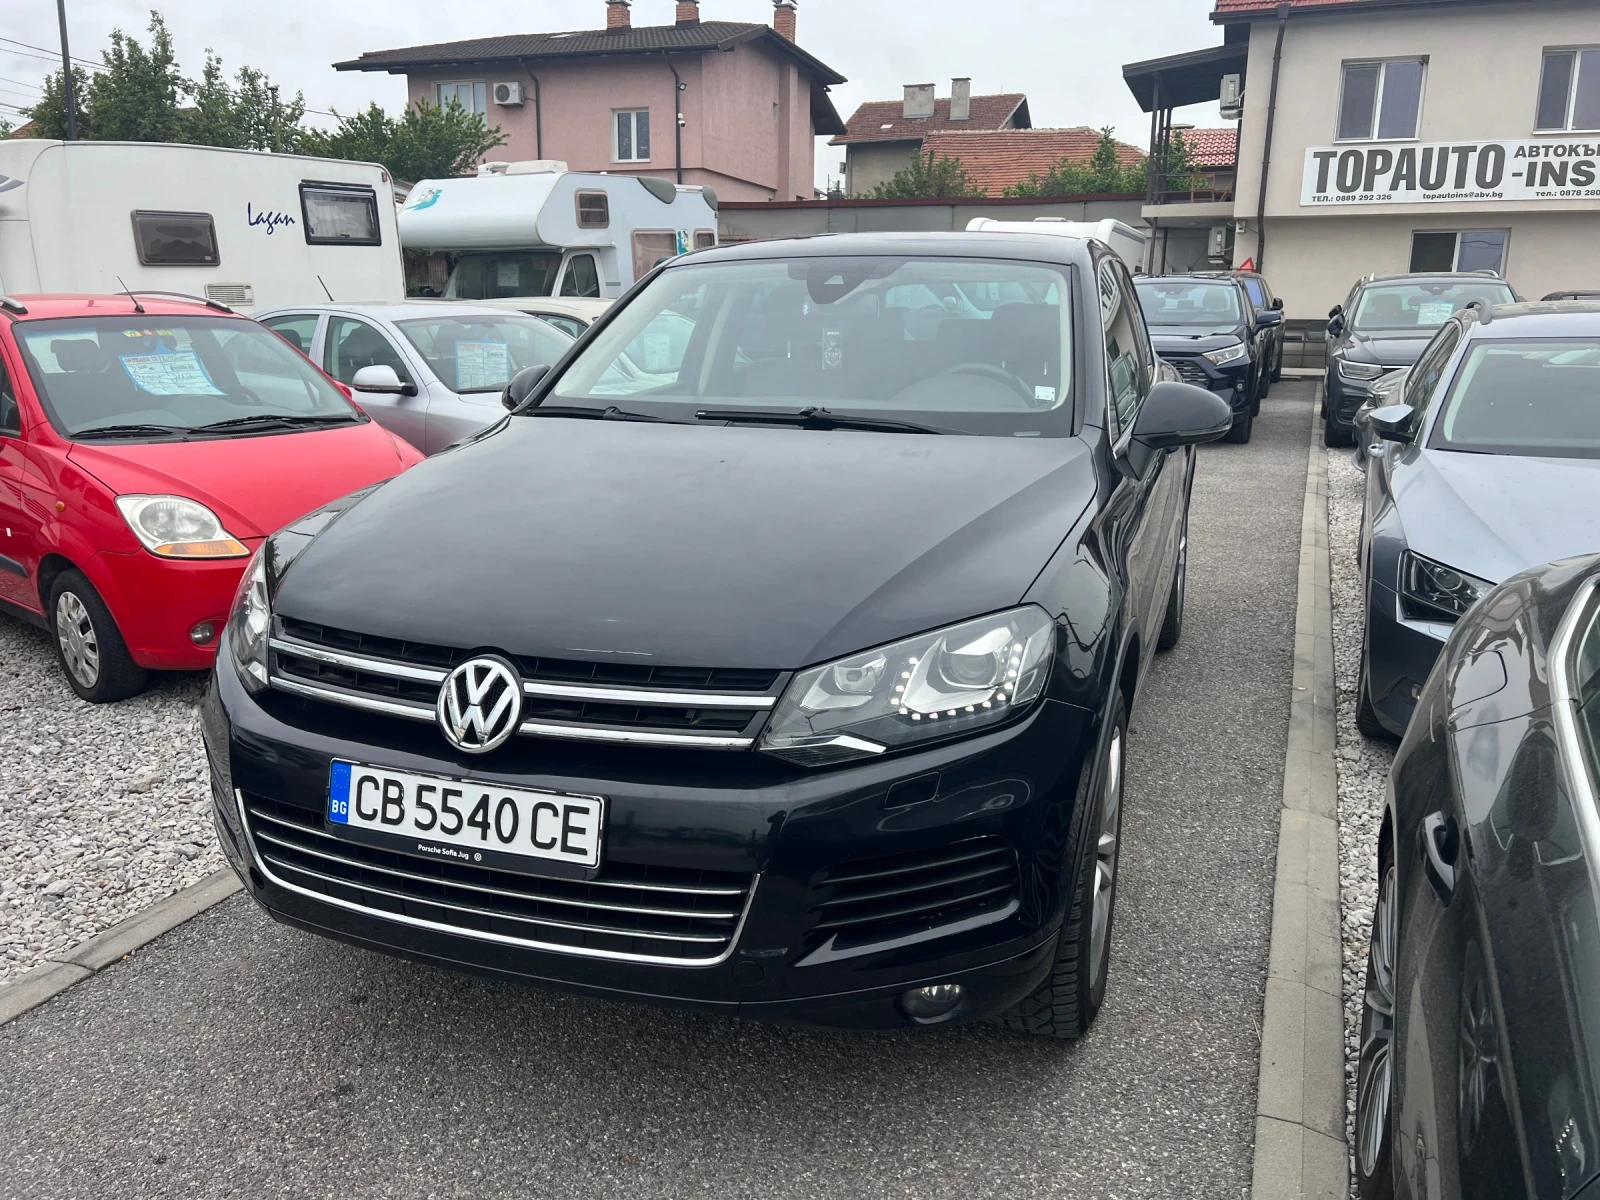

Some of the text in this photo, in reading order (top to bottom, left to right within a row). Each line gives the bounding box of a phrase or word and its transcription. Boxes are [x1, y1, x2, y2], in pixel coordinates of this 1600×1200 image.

[1513, 144, 1600, 158] АВТОКЪ
[1313, 144, 1506, 194] TOPAUTO
[1336, 194, 1356, 202] 0889
[1422, 191, 1503, 200] topautoins@abv.bg
[1559, 189, 1582, 197] 0878
[247, 201, 295, 235] Lagan
[331, 800, 347, 815] BG
[355, 775, 590, 856] CB 5540 CE
[417, 844, 469, 860] Porsche Sofia Jug
